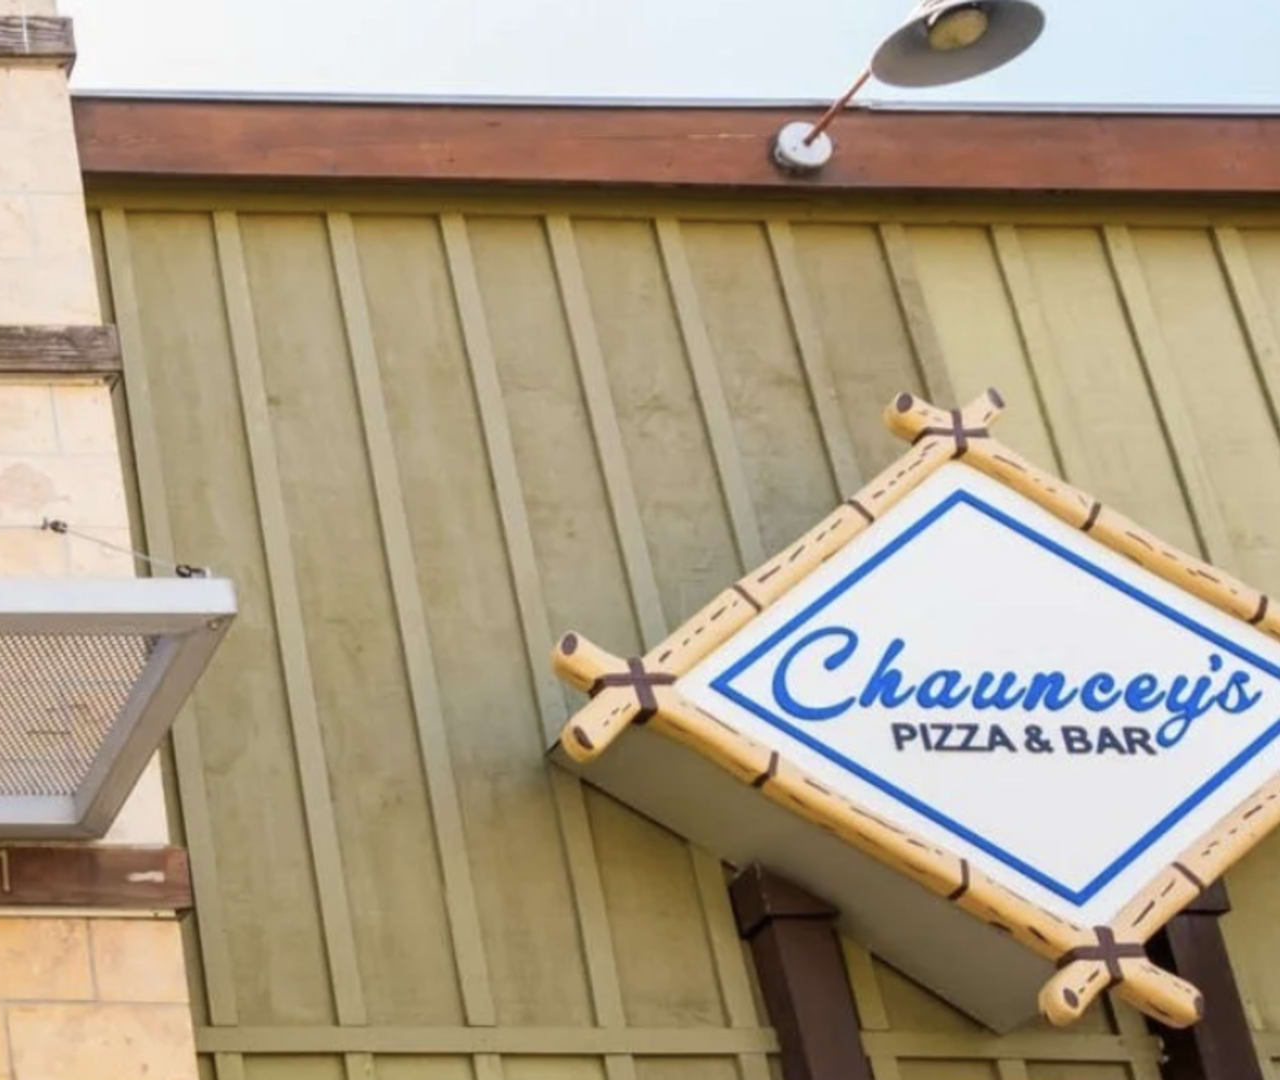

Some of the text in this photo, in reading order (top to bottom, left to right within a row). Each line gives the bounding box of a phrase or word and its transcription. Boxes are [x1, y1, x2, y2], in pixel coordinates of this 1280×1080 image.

[771, 626, 1263, 748] Chauncey's
[890, 722, 1159, 756] PIZZA & BAR
